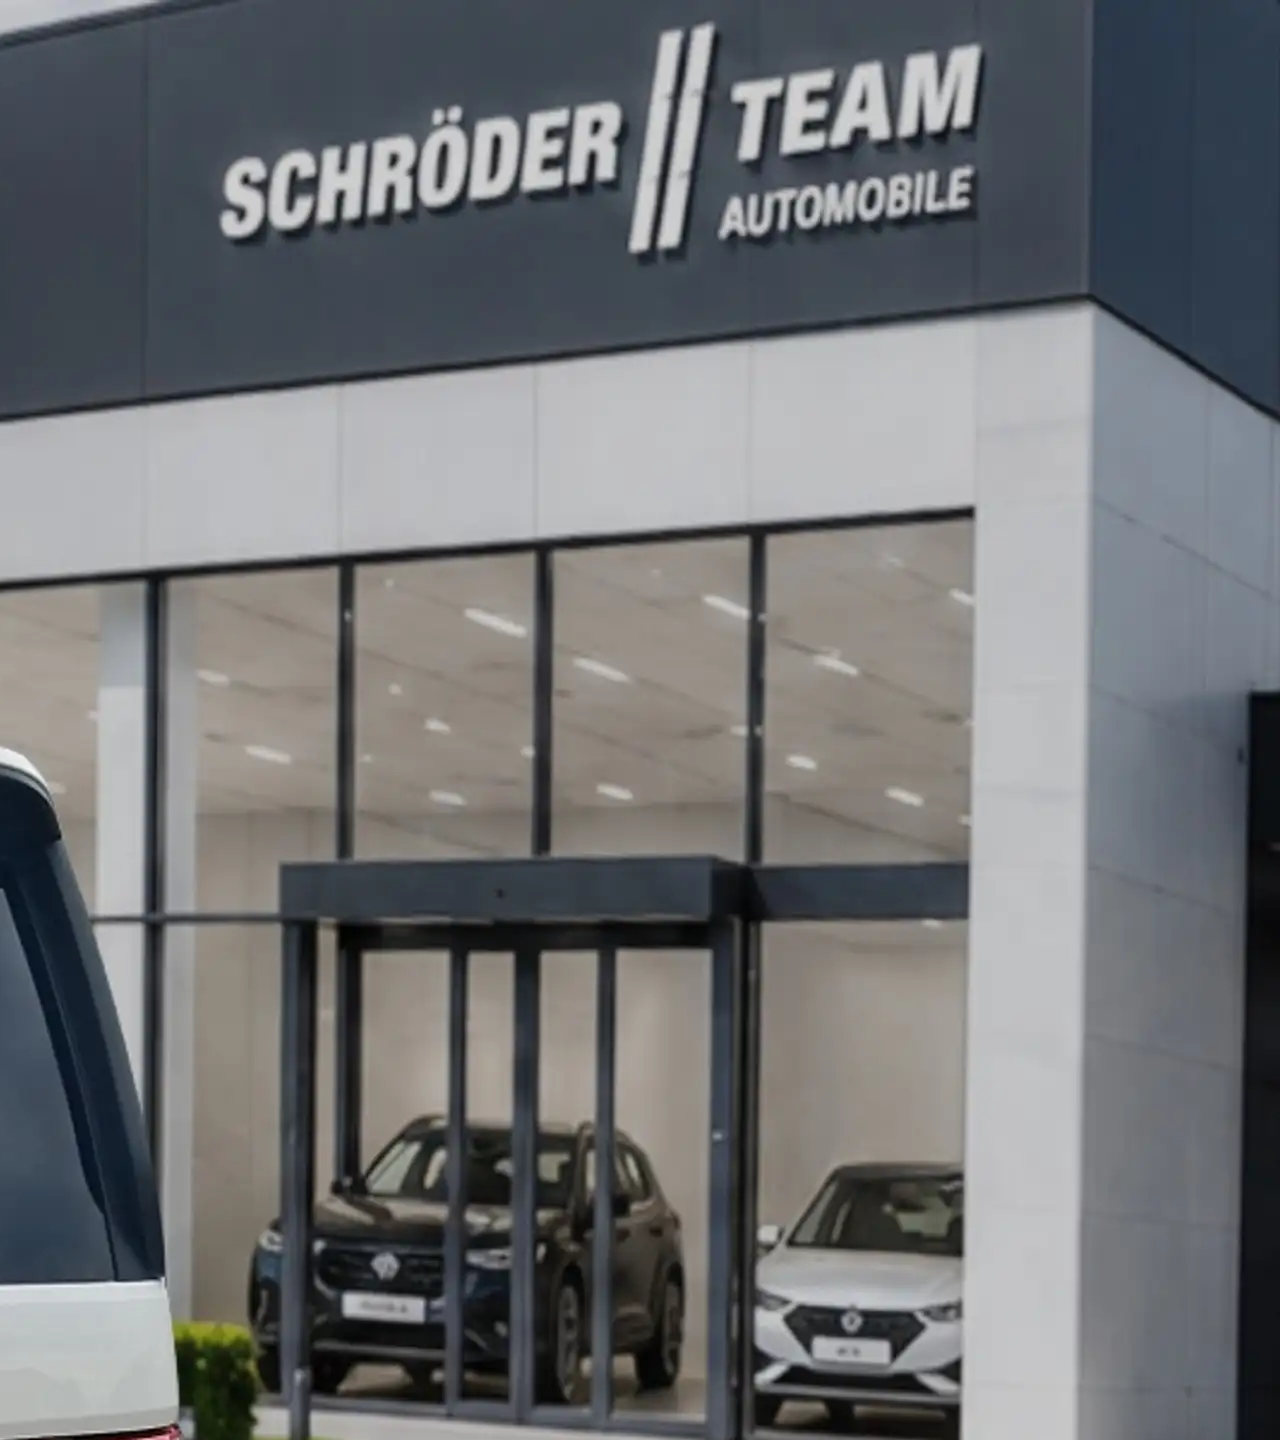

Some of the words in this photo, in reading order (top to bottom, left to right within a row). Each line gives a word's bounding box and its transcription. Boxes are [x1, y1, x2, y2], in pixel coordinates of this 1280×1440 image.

[220, 101, 623, 239] SCHRÖDER
[730, 44, 982, 163] TEAM
[718, 167, 975, 240] AUTOMOBILE
